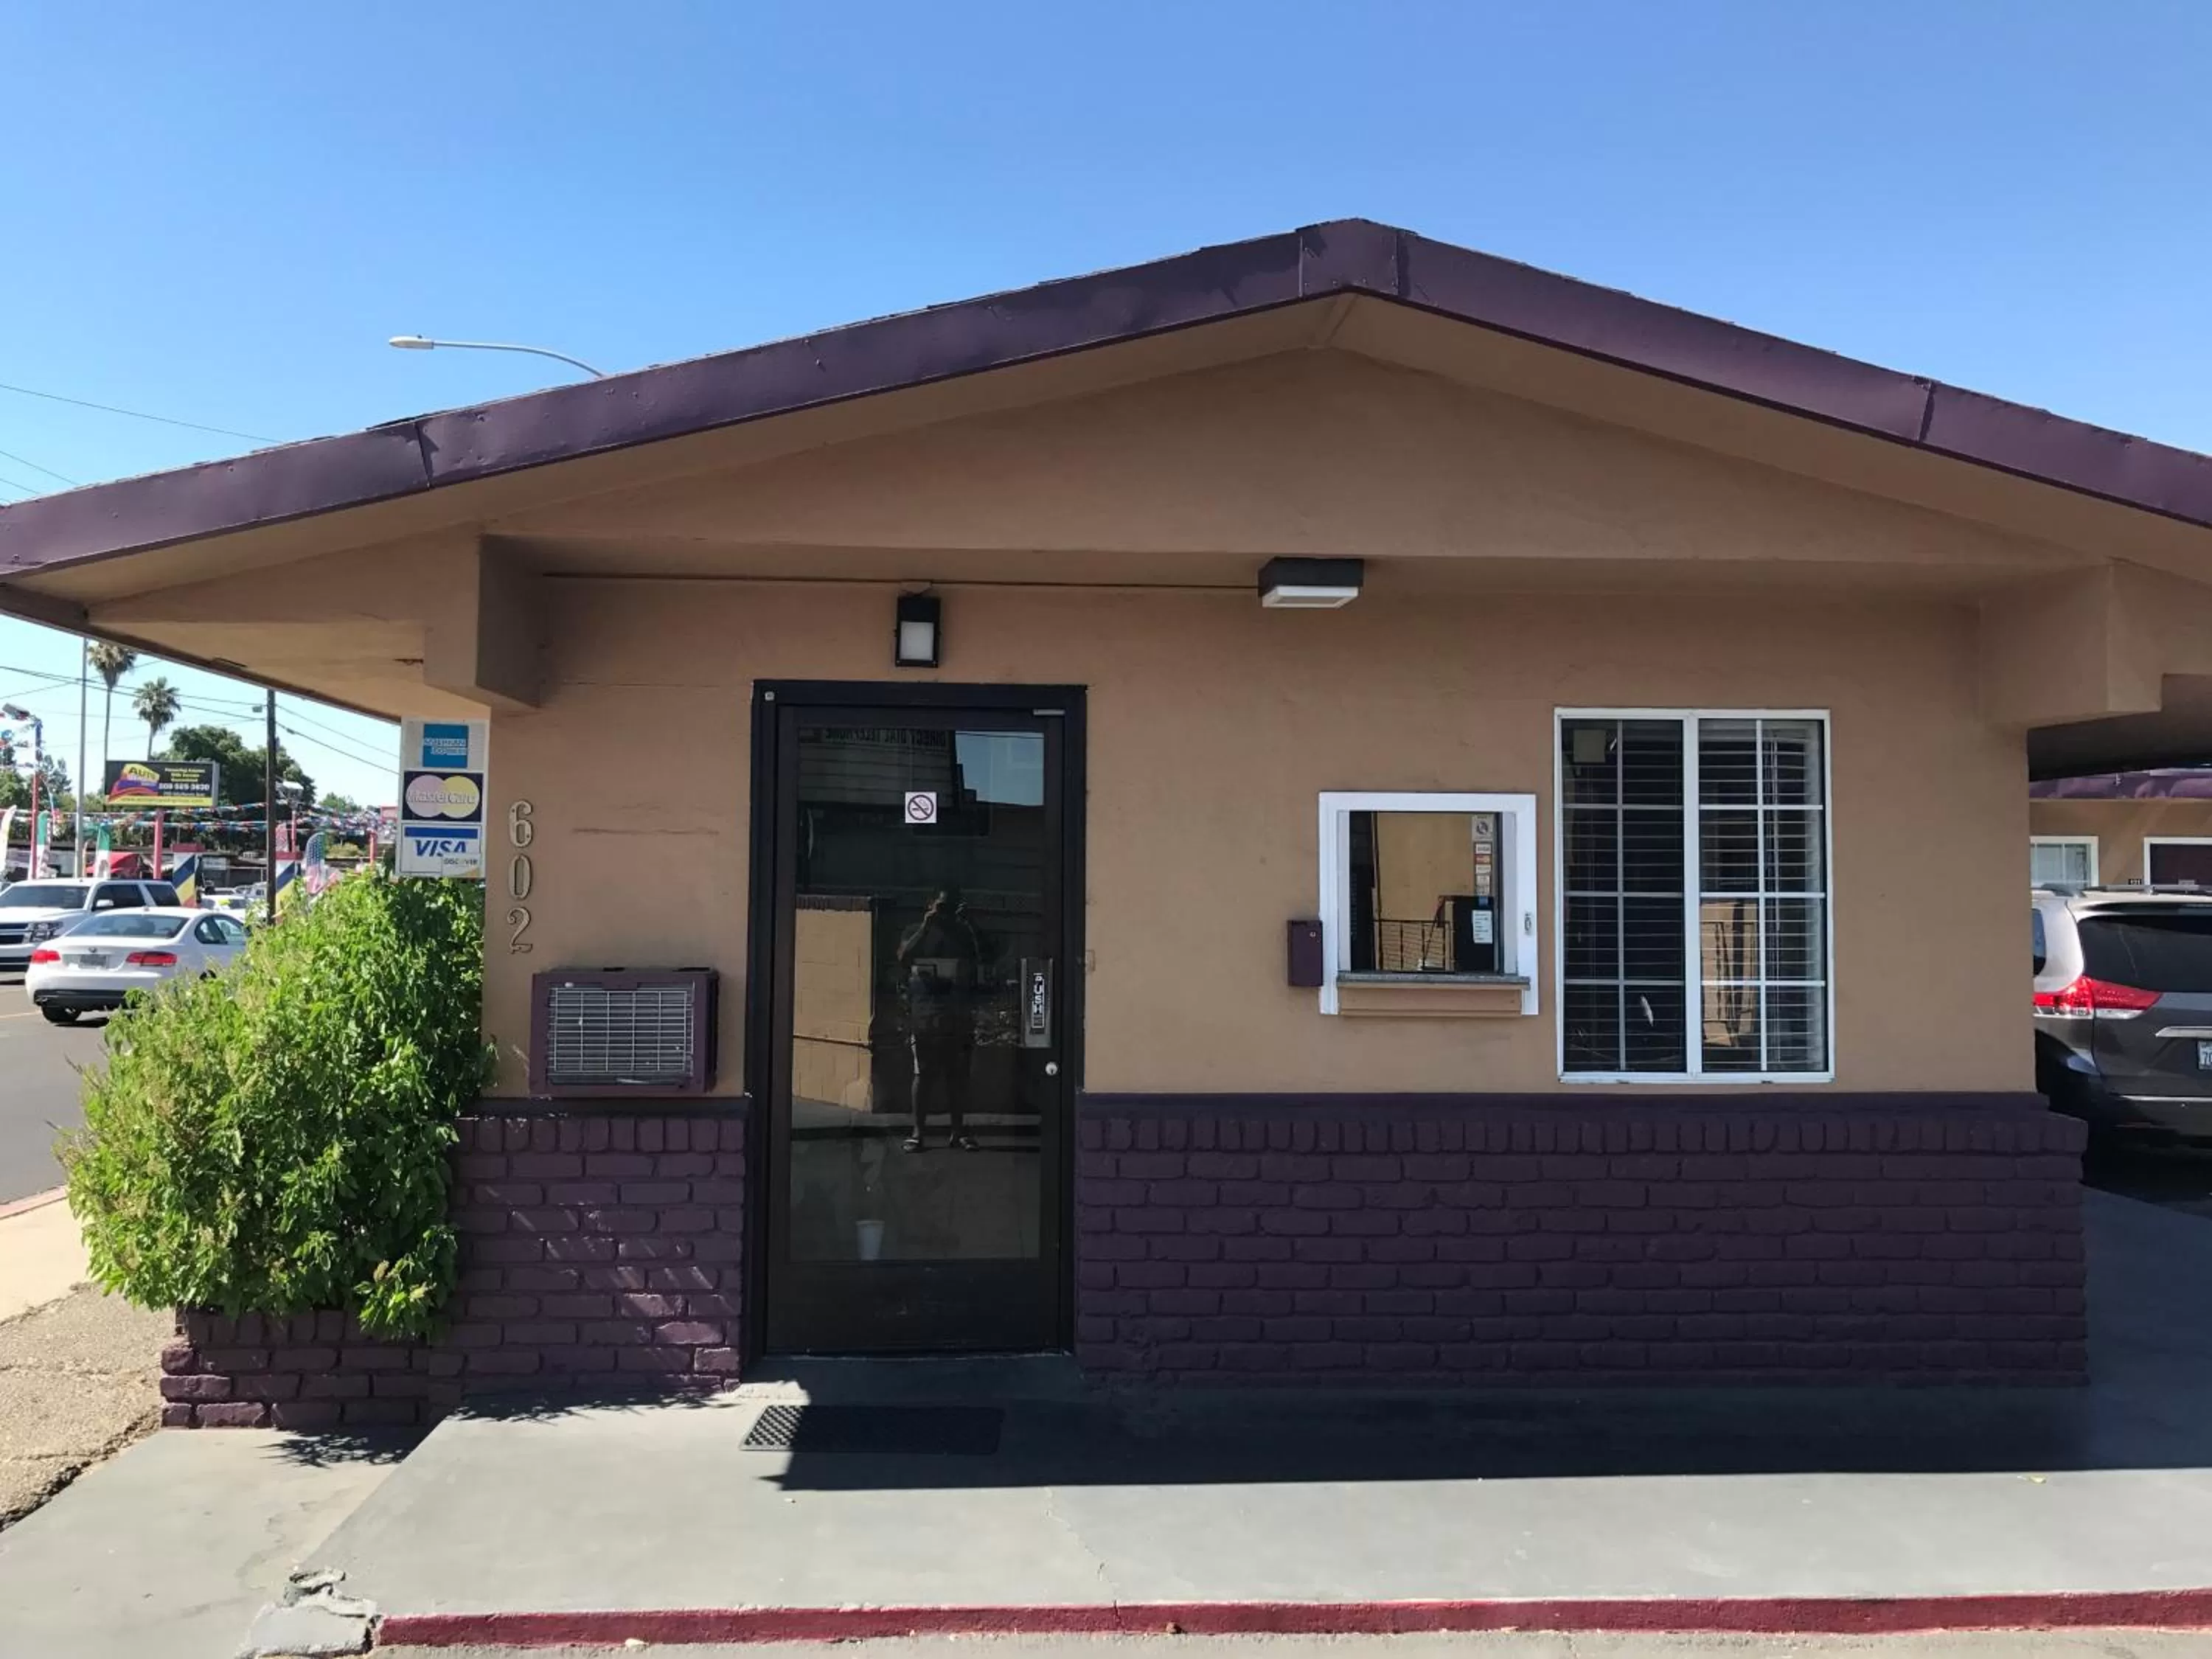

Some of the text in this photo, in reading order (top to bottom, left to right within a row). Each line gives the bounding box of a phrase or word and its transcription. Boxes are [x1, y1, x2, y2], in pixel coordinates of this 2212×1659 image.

[415, 839, 467, 858] VISA
[507, 799, 533, 954] 602
[1034, 975, 1043, 1014] PUSH
